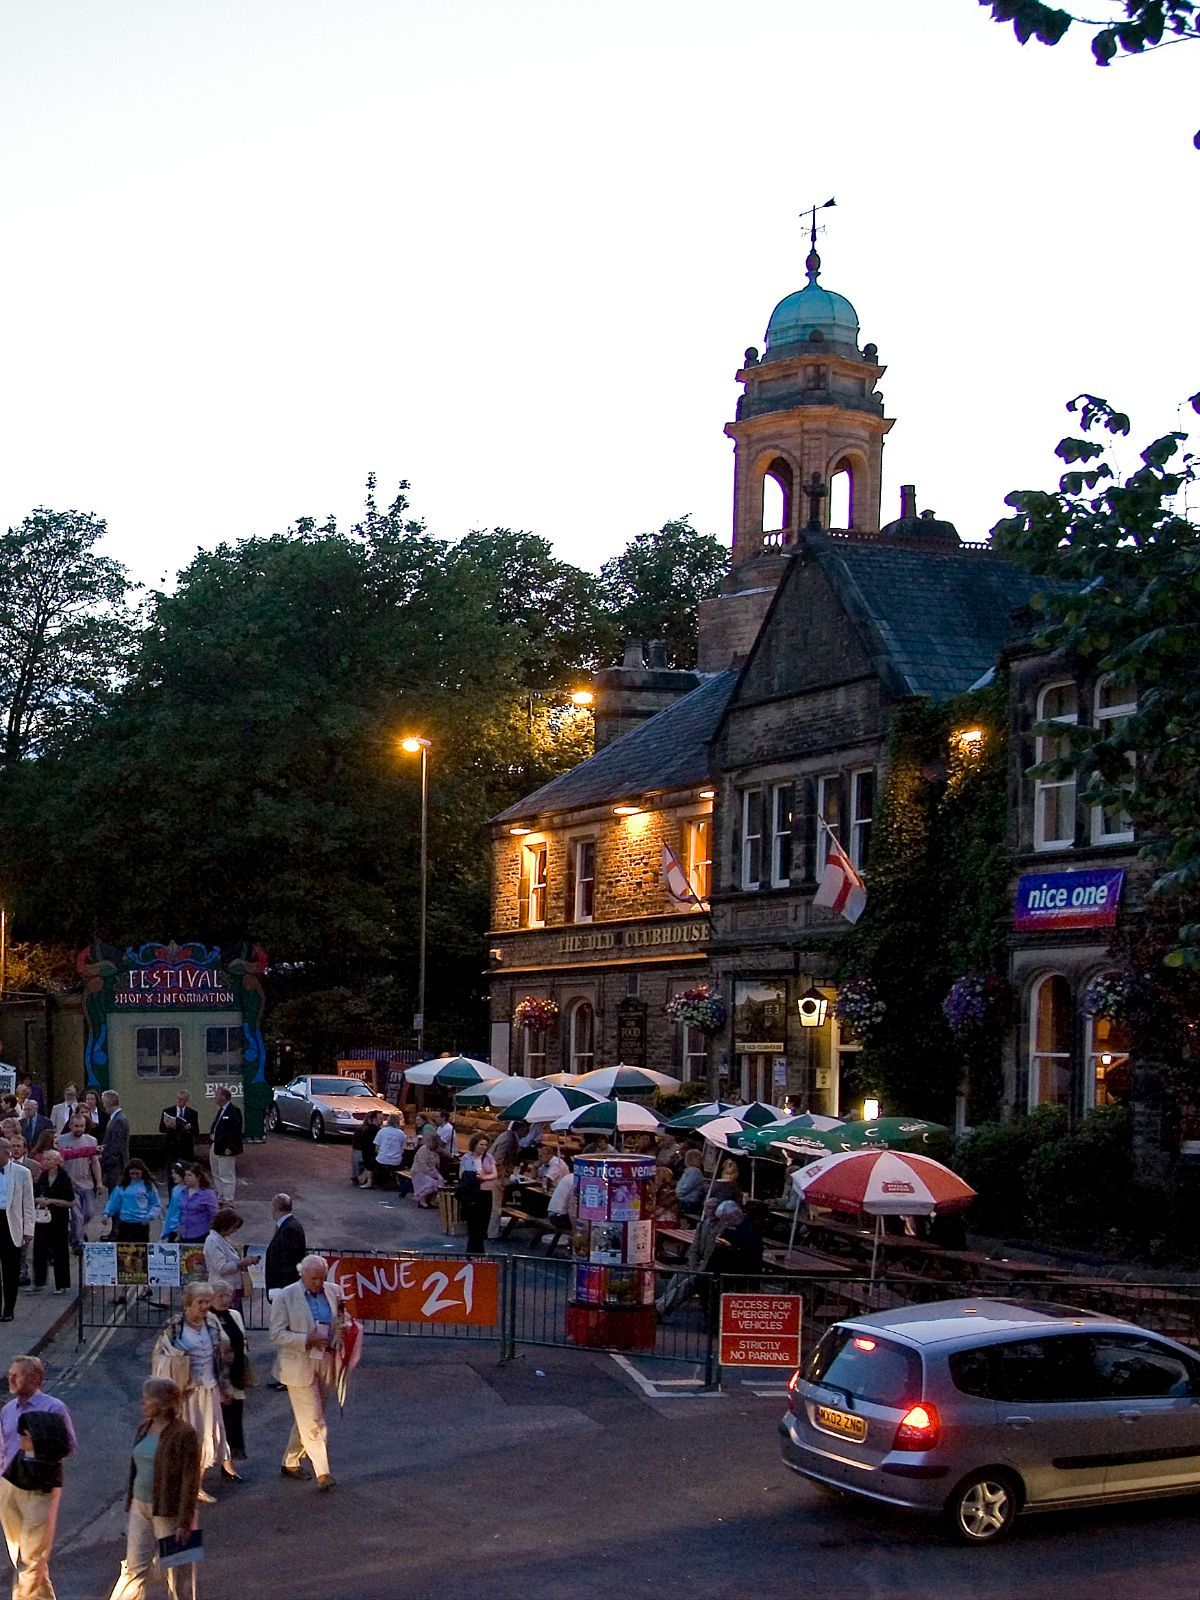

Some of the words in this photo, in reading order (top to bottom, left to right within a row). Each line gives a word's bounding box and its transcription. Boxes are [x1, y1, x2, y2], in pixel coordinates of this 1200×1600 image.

[1027, 883, 1068, 908] nice
[1071, 885, 1109, 906] one
[558, 936, 582, 953] THE
[587, 933, 615, 950] OLD
[624, 923, 710, 947] CLUBHOUSE
[128, 969, 223, 989] FESTIVAL
[114, 993, 142, 1004] SHOP
[158, 992, 234, 1004] INFORMATION
[344, 1070, 367, 1080] Food
[596, 1164, 623, 1178] nice
[420, 1263, 474, 1317] 21
[729, 1300, 770, 1310] ACCESS
[772, 1301, 792, 1310] FOR
[731, 1310, 790, 1320] EMERGENCY
[738, 1320, 783, 1330] VEHICLES
[739, 1340, 781, 1350] STRICTLY
[729, 1350, 746, 1360] NO
[748, 1351, 790, 1361] PARKING
